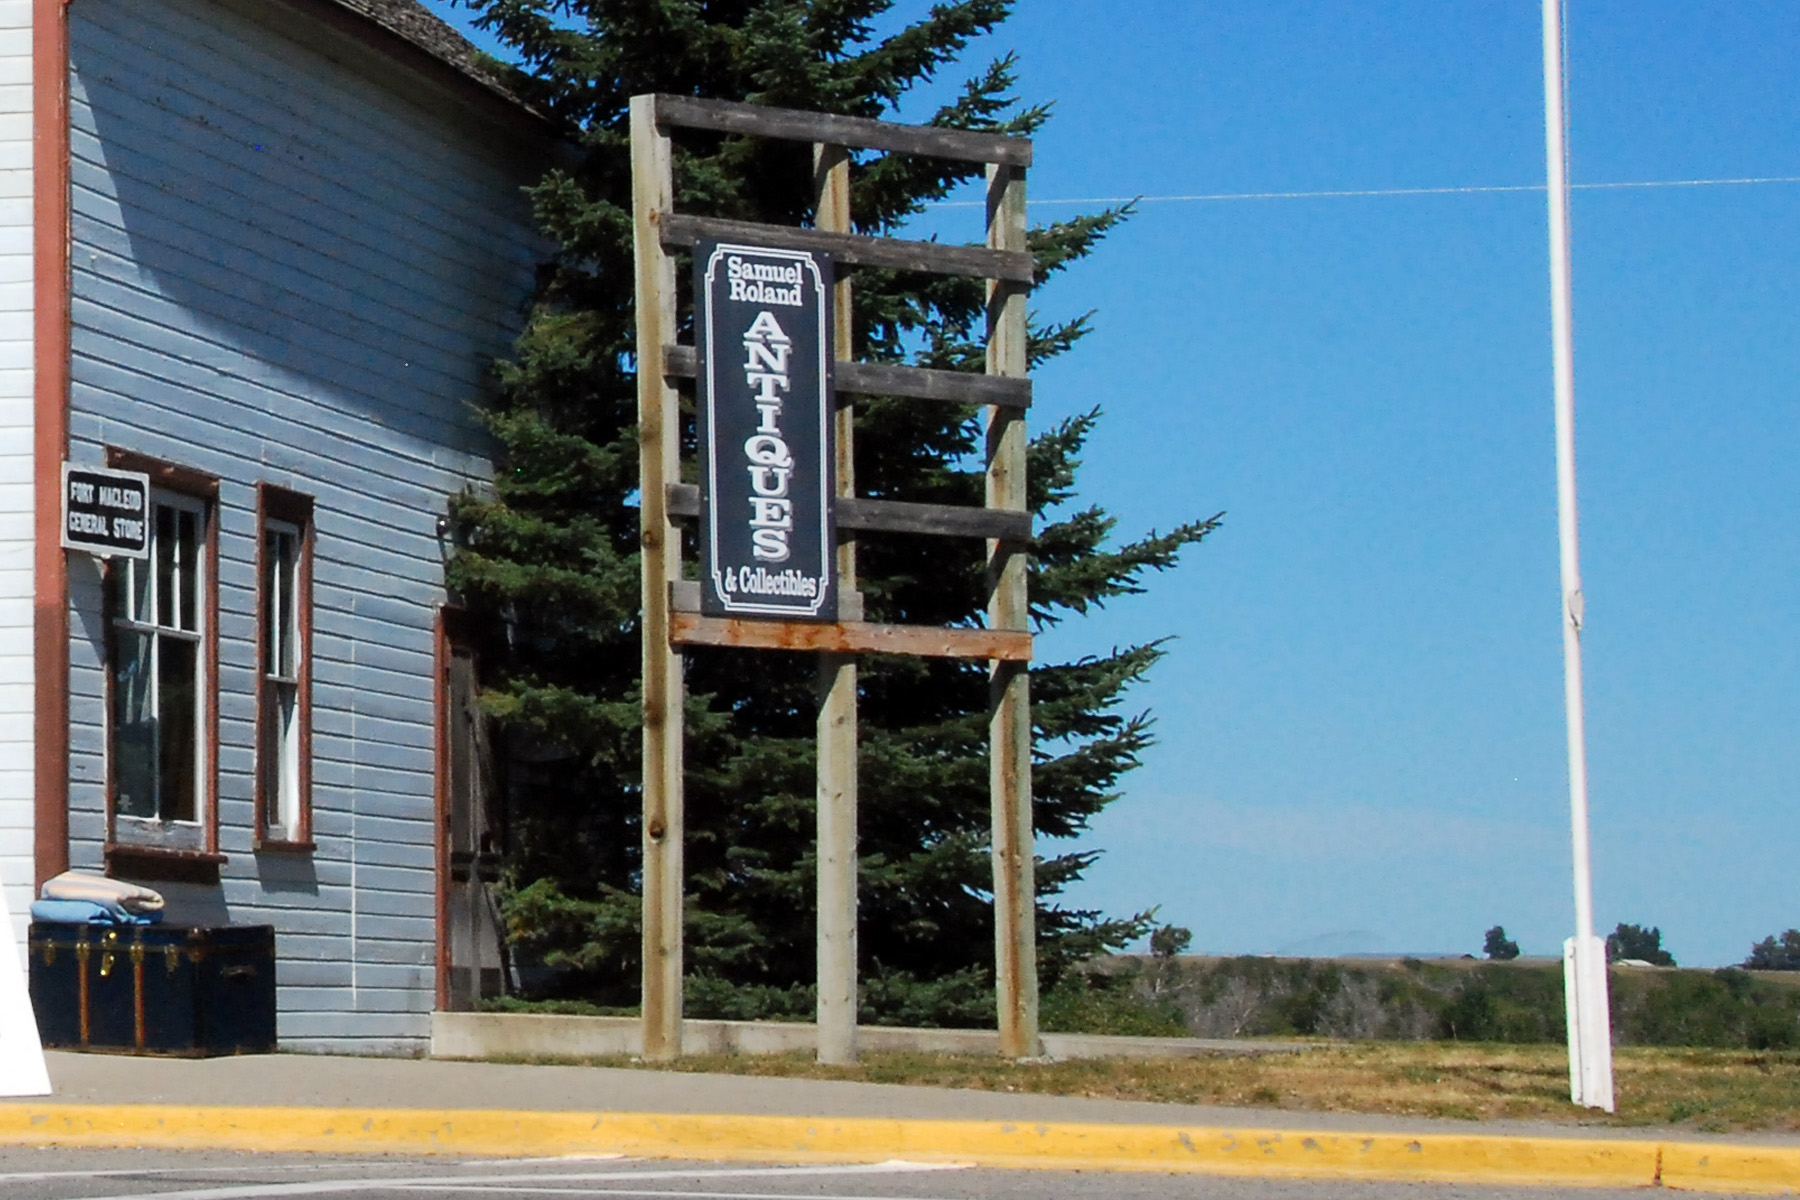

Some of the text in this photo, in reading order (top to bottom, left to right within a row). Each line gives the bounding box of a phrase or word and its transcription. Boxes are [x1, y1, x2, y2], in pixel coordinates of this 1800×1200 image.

[727, 256, 803, 284] Samuel
[729, 279, 802, 306] Roland
[743, 311, 795, 563] ANTIQUES
[70, 481, 94, 503] FORT
[69, 511, 143, 540] GENERAL STORE
[725, 566, 816, 597] & Collectibles
